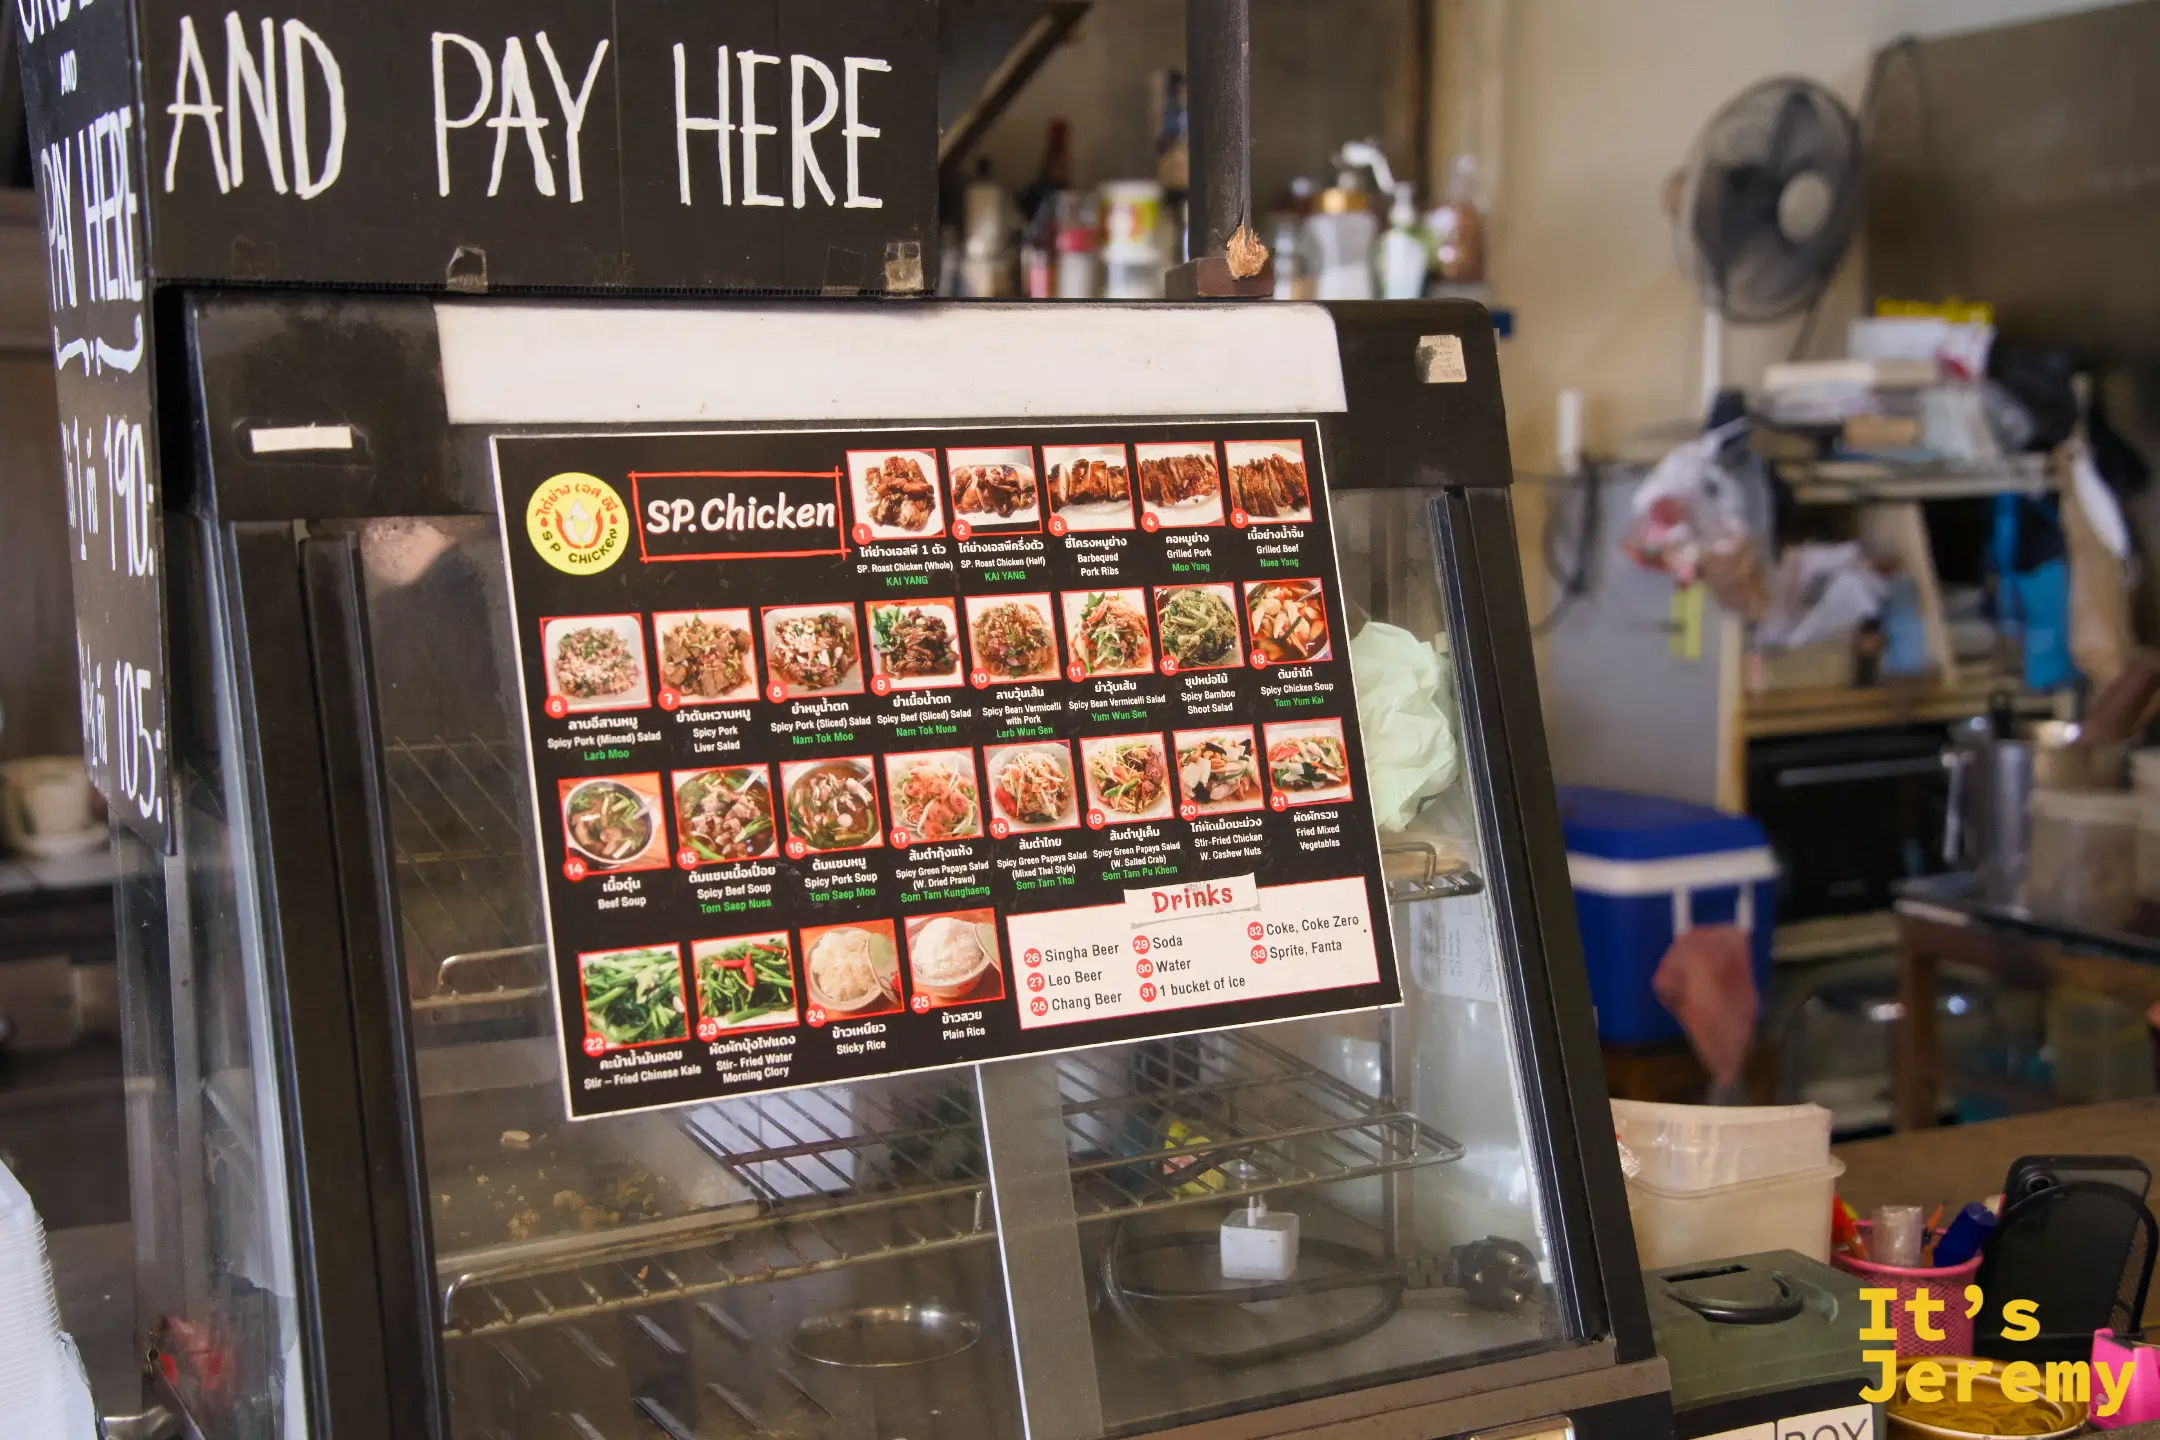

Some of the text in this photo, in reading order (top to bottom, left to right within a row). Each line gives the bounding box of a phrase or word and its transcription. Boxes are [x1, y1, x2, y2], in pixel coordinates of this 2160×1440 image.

[60, 49, 77, 96] AND
[164, 11, 892, 208] AND PAY HERE
[41, 105, 143, 312] PAY HERE
[1146, 517, 1154, 528] 4
[1235, 513, 1243, 524] 5
[959, 524, 965, 535] 2
[1054, 522, 1062, 531] 3
[859, 528, 865, 539] 1
[1166, 533, 1210, 545] คอหมูย่าง
[1248, 526, 1304, 540] เนื้อย่างน้ำจิ้ม
[568, 528, 617, 564] CHICKEN
[958, 536, 1044, 554] ไก่ย่างเอสพีครึ่งตัว
[1065, 534, 1127, 550] ซี่โครงหมูย่าง
[860, 544, 946, 558] ไก่ย่างเอสพี 1 ตัว
[1167, 548, 1212, 559] Grilled Pork
[1256, 544, 1299, 554] Grilled Beef
[961, 556, 1046, 569] SP. Roast Chicken (Half)
[1077, 552, 1118, 563] Barbequed
[1280, 558, 1299, 567] Yang
[857, 561, 953, 573] SP. Roast Chicken (Whole)
[1080, 566, 1119, 576] Pork Ribs
[1172, 562, 1210, 572] Moo Yang
[886, 575, 928, 586] KAI YANG
[985, 571, 1025, 581] KAI YANG
[1252, 654, 1264, 664] 13
[1162, 660, 1175, 671] 12
[1071, 667, 1081, 677] 11
[1278, 666, 1313, 679] ต้มยำไก่
[973, 673, 987, 684] 10
[876, 680, 886, 690] 9
[1095, 680, 1137, 693] ยำวุ้นเส้น
[773, 686, 782, 697] 8
[996, 686, 1044, 702] ลาบวุ้นเส้น
[1181, 690, 1236, 702] Spicy Bamboo
[664, 693, 673, 705] 7
[893, 690, 952, 708] ยำเนื้อน้ำตก
[1274, 696, 1324, 707] Tom Yum Kai
[552, 700, 562, 712] 6
[791, 697, 849, 717] ยำหมูน้ำตก
[983, 702, 1061, 717] Spicy Bean Vermicelli
[1187, 703, 1233, 714] Shoot Salad
[676, 708, 751, 723] ยำตับหวานหมู
[1006, 715, 1041, 726] with Pork
[693, 726, 738, 739] Spicy Pork
[996, 726, 1053, 738] Larb Wun Sen
[793, 732, 854, 745] Nam Tok Moo
[694, 741, 740, 753] Liver Salad
[1272, 795, 1284, 806] 21
[1181, 806, 1196, 816] 20
[1294, 810, 1339, 823] ผัดผักรวม
[1089, 814, 1103, 824] 19
[992, 823, 1007, 834] 18
[1110, 826, 1160, 842] ส้มตำปูเค็ม
[1296, 825, 1340, 837] Fried Mixed
[894, 832, 907, 844] 17
[1019, 836, 1062, 851] ส้มตำไทย
[1194, 833, 1263, 848] Stir-Fried Chicken
[789, 842, 804, 853] 16
[1300, 839, 1340, 852] Vegetables
[680, 852, 695, 864] 15
[909, 845, 973, 863] ส้มตำกุ้งแห้ง
[567, 863, 582, 875] 14
[1152, 884, 1233, 913] Drinks
[1249, 915, 1359, 936] 32 Coke, Coke Zero
[1135, 935, 1183, 950] 29 Soda
[1026, 943, 1120, 963] 26 Singha Beer
[1253, 940, 1342, 960] 33 Sprite, Fanta
[1138, 959, 1191, 973] 30 Water
[1029, 970, 1103, 988] 27 Leo Beer
[1142, 976, 1245, 997] 31 1 bucket of ice
[913, 996, 929, 1008] 25
[1032, 992, 1122, 1013] 28 Chang Beer
[808, 1010, 826, 1022] 24
[942, 1009, 982, 1024] ข้าวสวย
[699, 1023, 717, 1036] 23
[832, 1021, 886, 1039] ข้าวเหนียว
[943, 1026, 985, 1040] Plain Rice
[586, 1038, 604, 1050] 22
[836, 1040, 886, 1055] Sticky Rice
